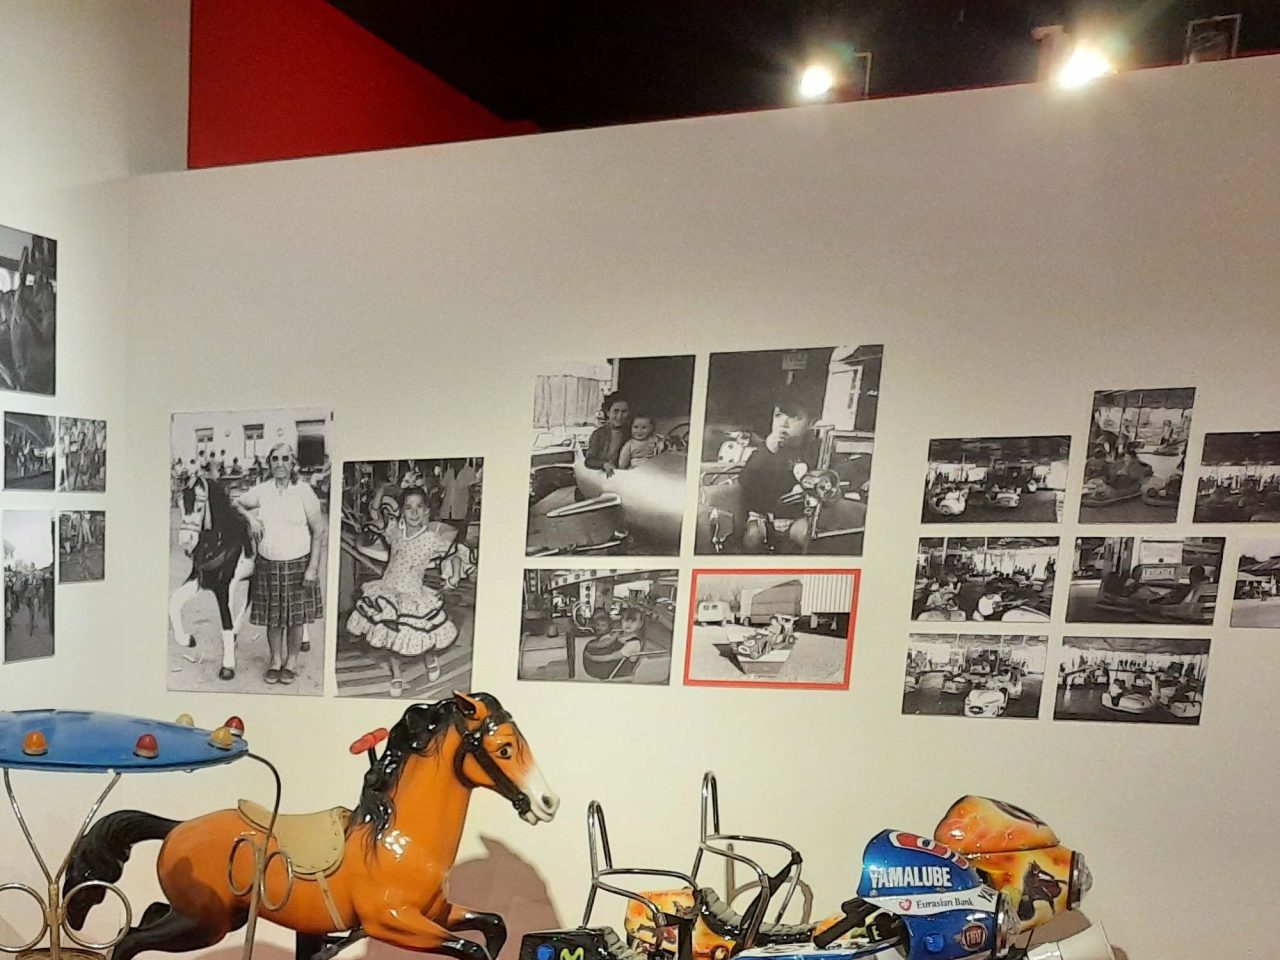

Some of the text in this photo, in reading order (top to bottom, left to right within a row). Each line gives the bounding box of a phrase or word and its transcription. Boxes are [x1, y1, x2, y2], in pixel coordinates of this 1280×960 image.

[870, 866, 952, 888] YAMALUBE
[916, 897, 974, 910] Eurasian Bank
